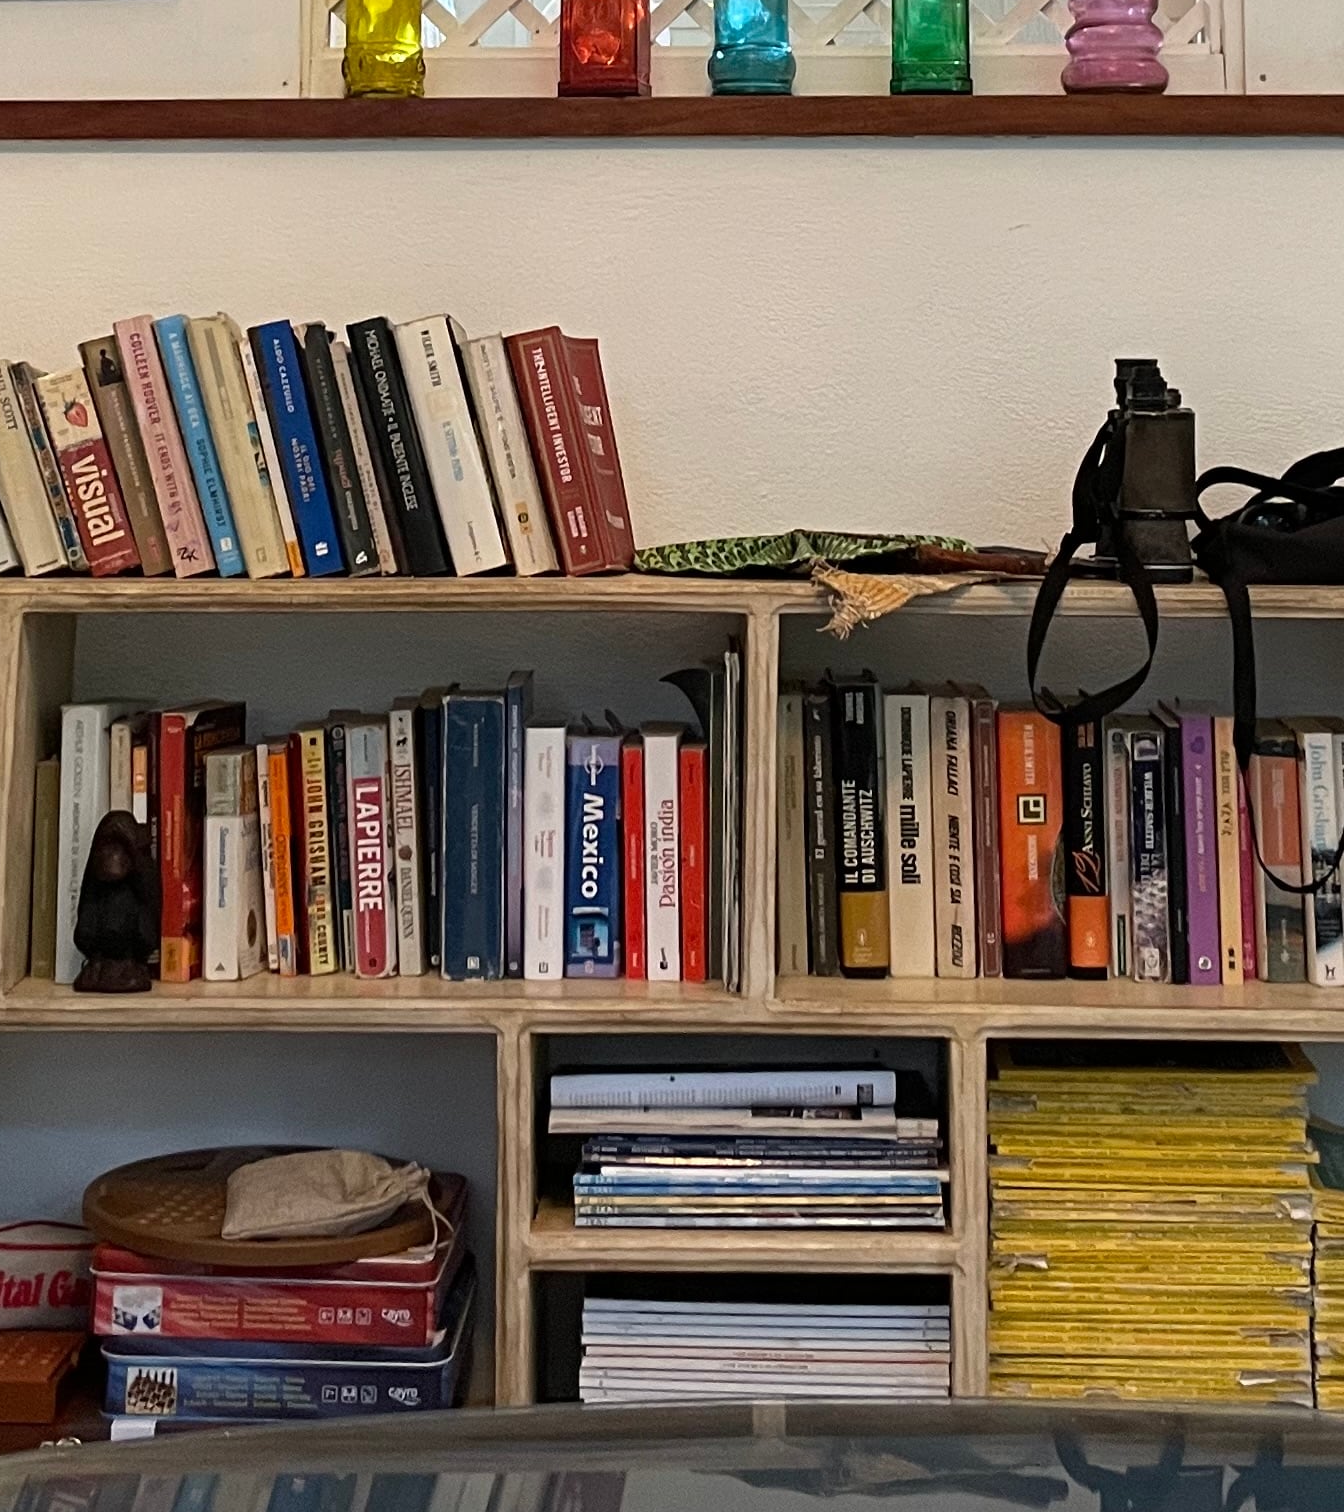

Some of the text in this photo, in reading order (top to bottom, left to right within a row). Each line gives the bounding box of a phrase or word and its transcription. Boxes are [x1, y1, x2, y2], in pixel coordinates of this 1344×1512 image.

[129, 333, 149, 379] COLLEEN
[364, 329, 383, 370] MICHAEL
[171, 341, 191, 392] MARRIAGE
[186, 407, 199, 428] SEA
[272, 338, 294, 413] ALDO CAZZULLO
[373, 371, 396, 416] ONDAATJE
[427, 360, 442, 387] SMITH
[0, 397, 18, 430] SCOTT
[141, 381, 160, 424] HOOVER
[154, 432, 165, 443] IT
[536, 370, 561, 432] INTELLIGENT
[551, 433, 573, 484] INVESTOR
[157, 443, 172, 470] ENDS
[389, 433, 410, 474] PAZIENTE
[71, 453, 124, 545] visual
[163, 473, 179, 497] WITH
[196, 438, 225, 527] SOPHIE ELMHIRST
[398, 475, 418, 511] INGLESE
[945, 710, 958, 750] ORIANA
[946, 754, 959, 796] FALLACI
[394, 763, 413, 834] ISHMAEL
[1309, 743, 1332, 855] John Grisham
[580, 792, 604, 899] Mexico
[841, 779, 858, 884] IL COMANDANTE
[859, 789, 876, 884] DI AUSCHWITZ
[899, 804, 920, 848] mille
[948, 814, 961, 850] NIENTE
[1072, 763, 1100, 892] 12 ANNI SCHIAVO
[1145, 813, 1154, 849] SMITH
[355, 785, 383, 912] LAPIERRE
[657, 800, 676, 908] Pasión india
[901, 853, 921, 885] soli
[949, 854, 961, 862] E
[306, 778, 329, 965] JOHN GRISHAM COUNTY
[950, 887, 962, 904] SIA
[388, 1386, 419, 1403] cayro
